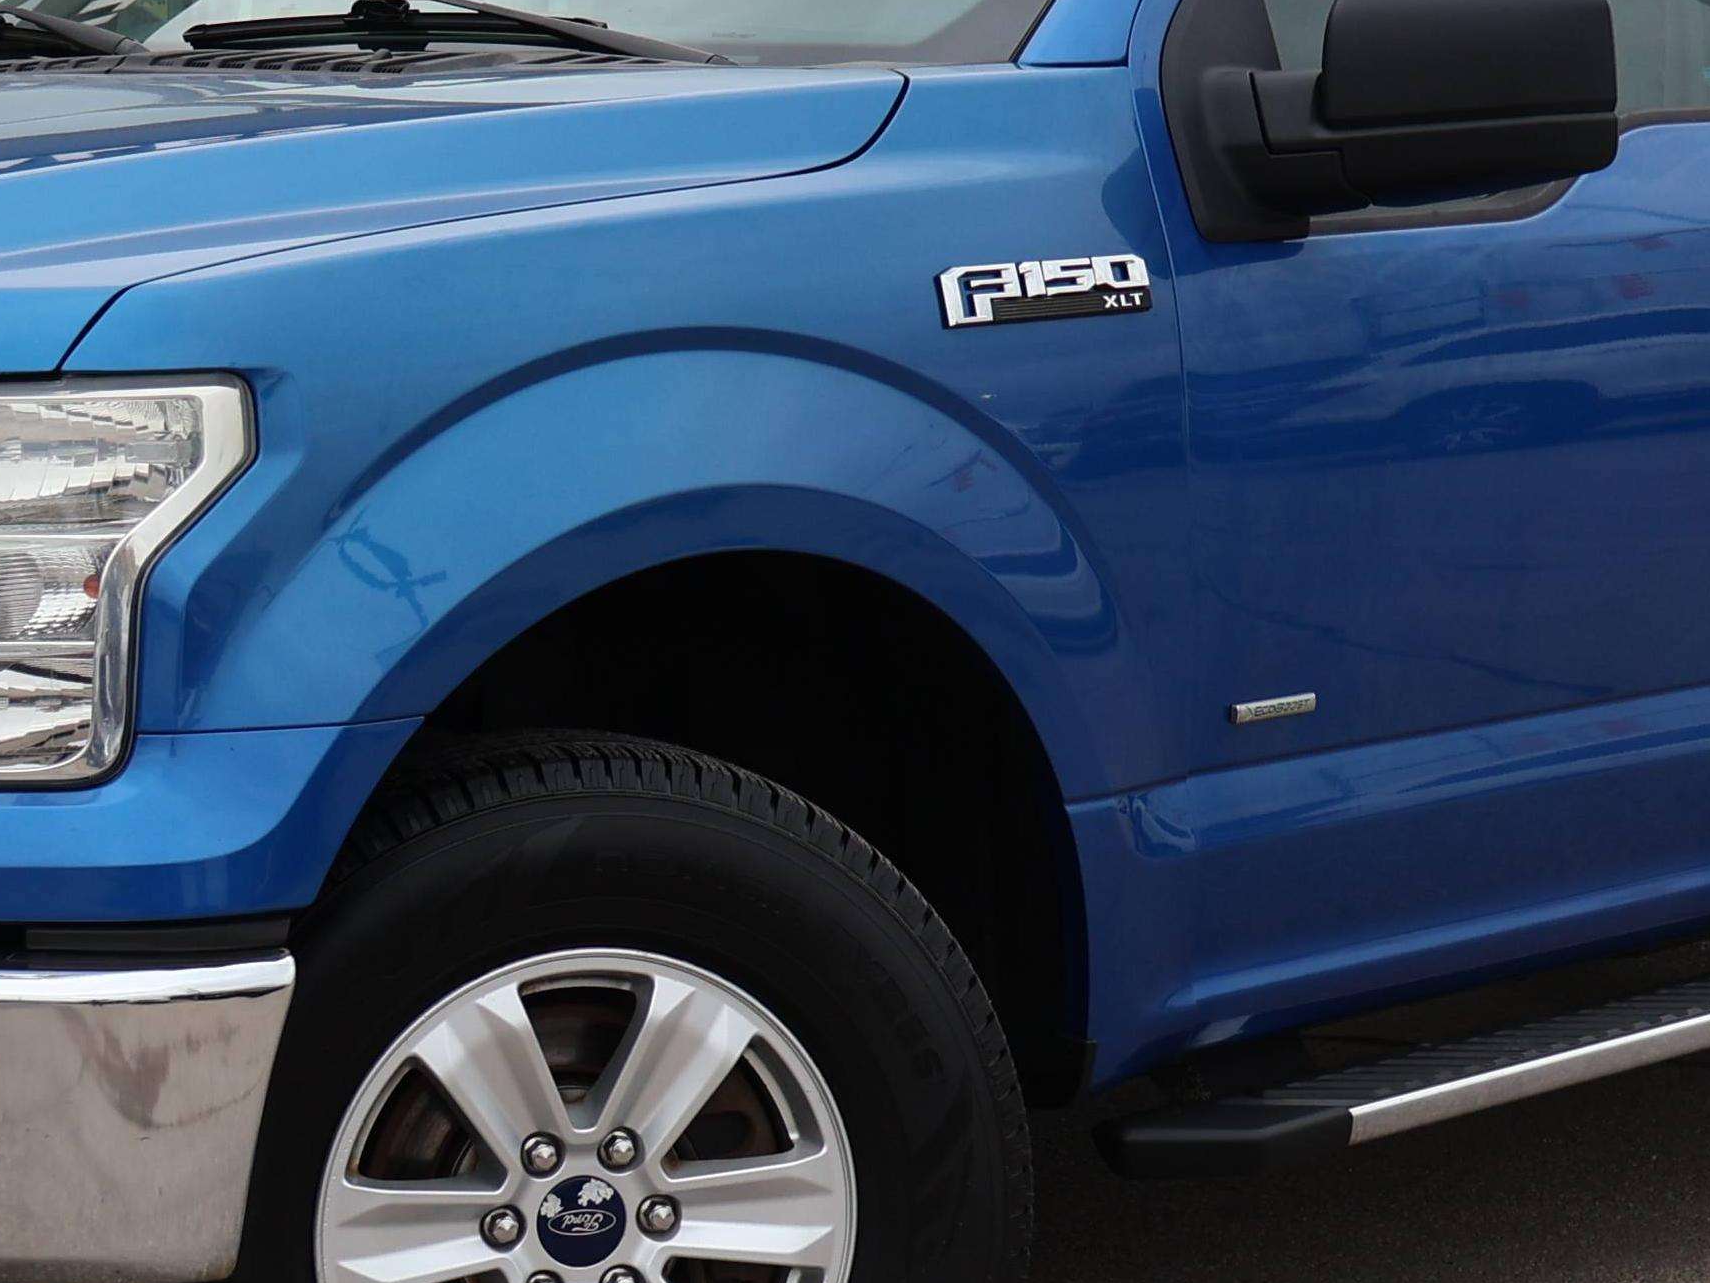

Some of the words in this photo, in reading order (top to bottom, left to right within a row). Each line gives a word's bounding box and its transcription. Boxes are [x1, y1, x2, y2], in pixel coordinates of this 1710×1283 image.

[939, 254, 1150, 327] F150
[1103, 293, 1144, 309] XLT
[561, 1213, 604, 1232] Ford
